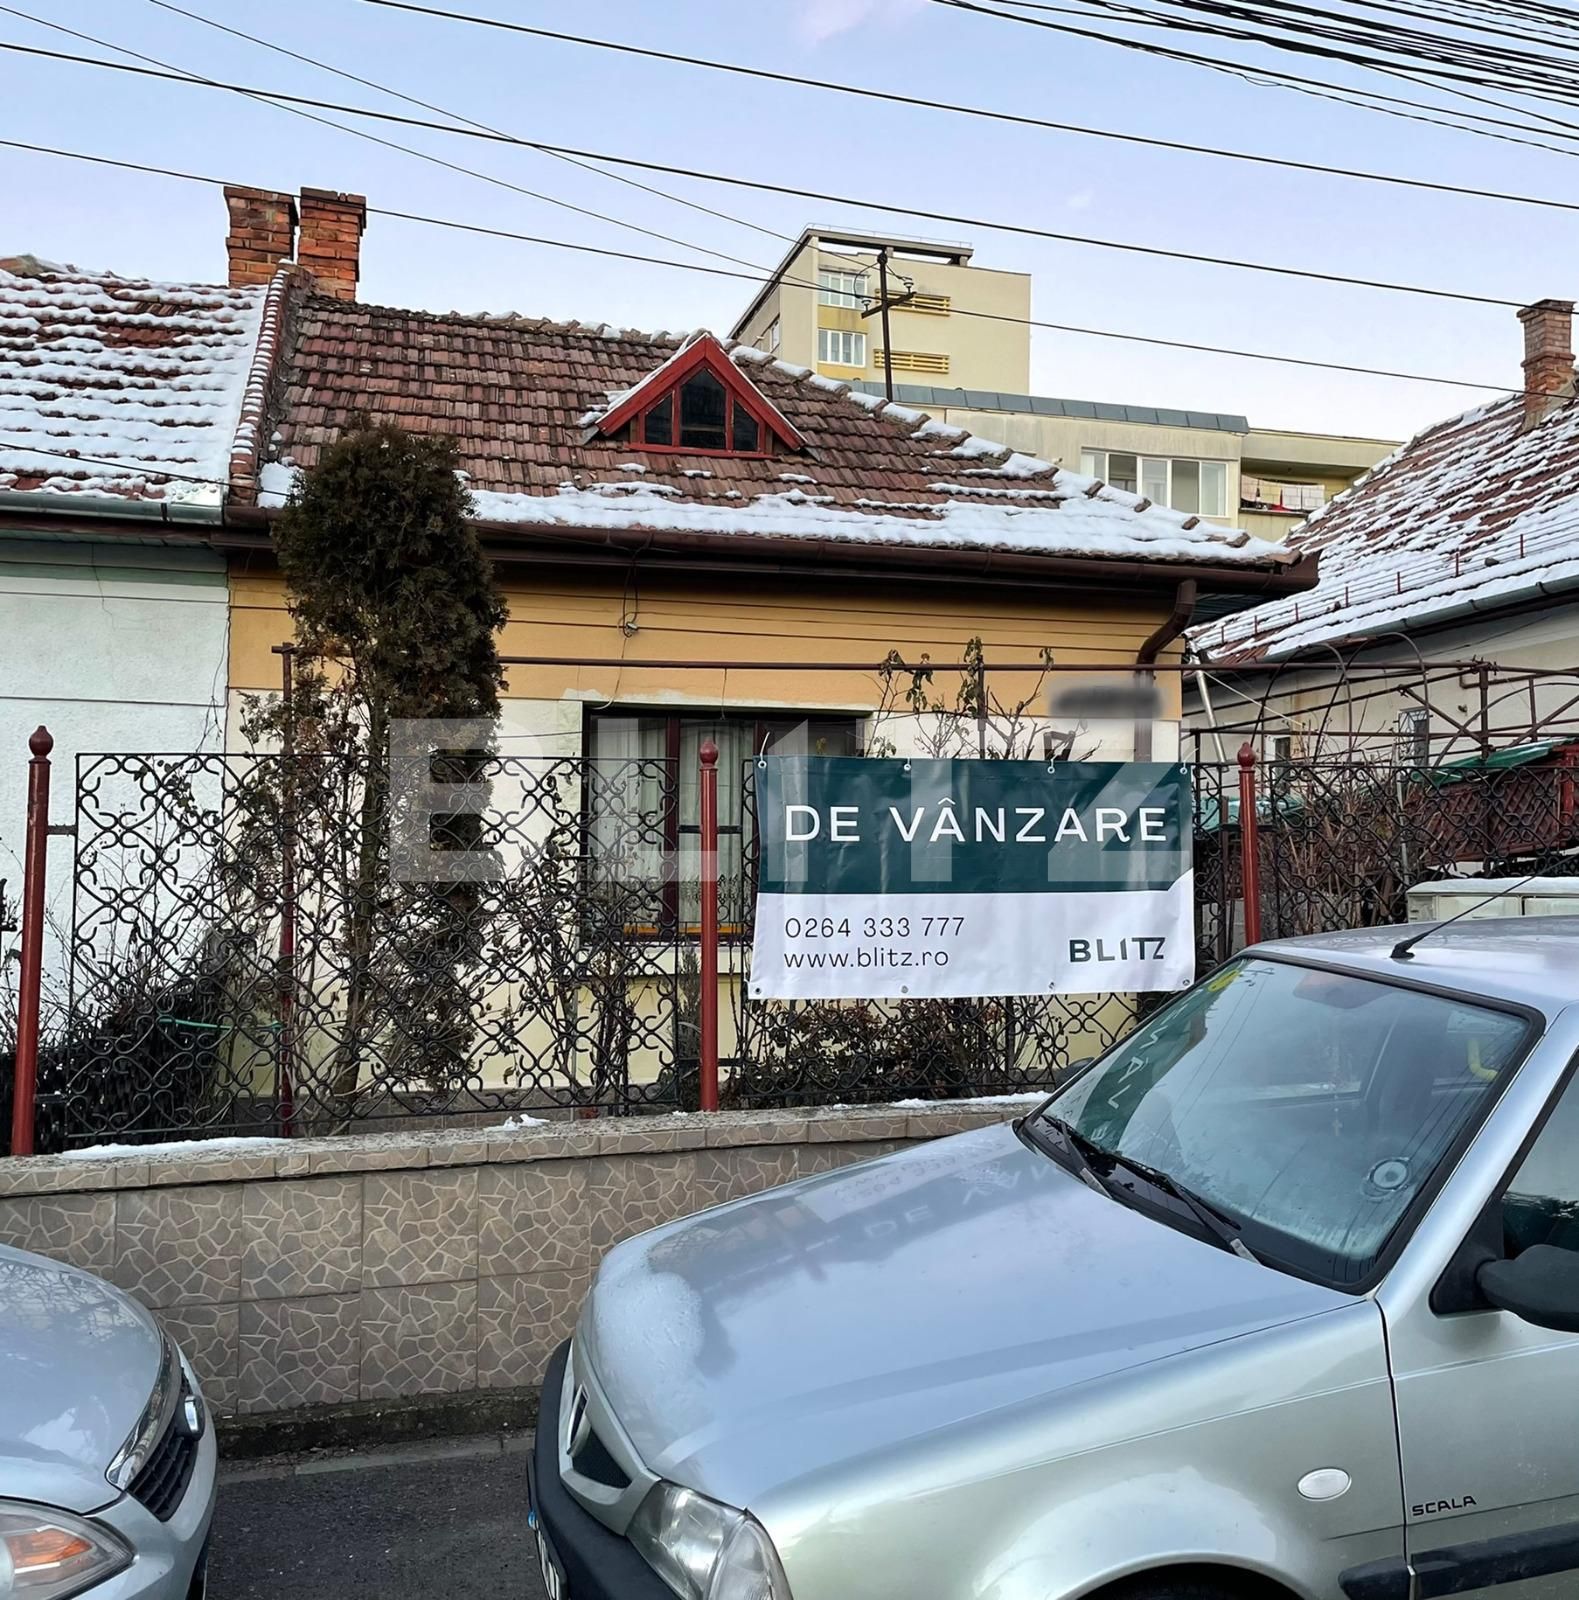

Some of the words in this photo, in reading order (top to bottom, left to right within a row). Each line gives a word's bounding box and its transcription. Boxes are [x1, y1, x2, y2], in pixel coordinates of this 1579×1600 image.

[785, 805, 860, 842] DE
[890, 797, 1166, 842] VÂNZARE
[785, 917, 851, 938] 0264
[863, 917, 910, 938] 333
[921, 916, 965, 937] 777
[784, 946, 949, 968] www.blitz.ro
[1069, 936, 1166, 963] BLITZ
[1411, 1495, 1477, 1516] SCALA
